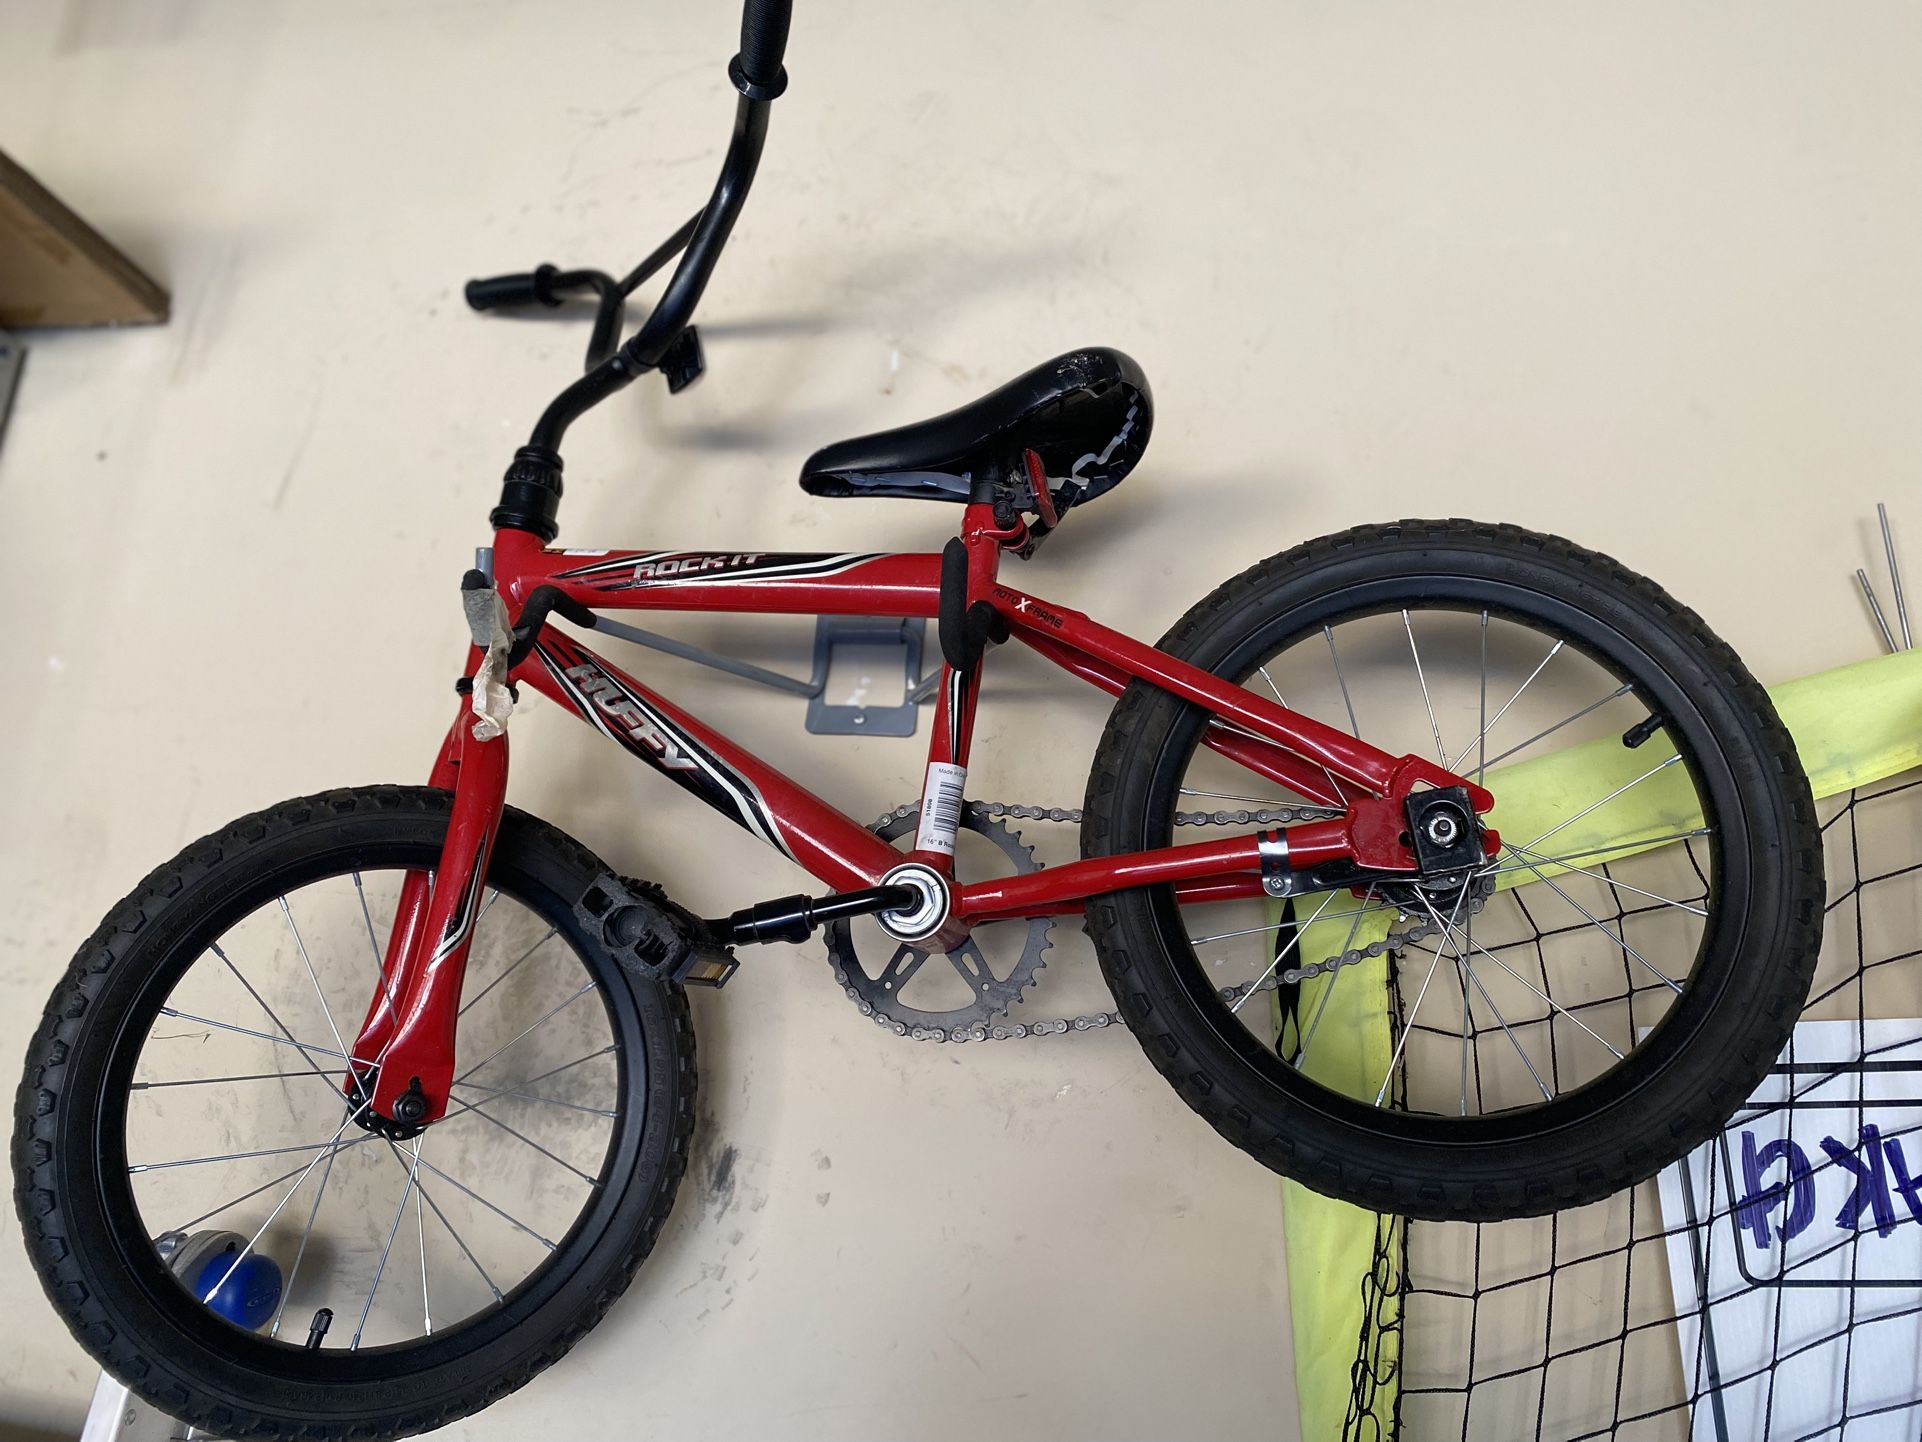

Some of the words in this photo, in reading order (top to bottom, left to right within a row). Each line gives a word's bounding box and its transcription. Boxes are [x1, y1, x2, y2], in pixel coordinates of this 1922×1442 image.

[632, 556, 727, 579] ROCK
[731, 553, 766, 566] IT
[565, 663, 699, 770] HUFFY
